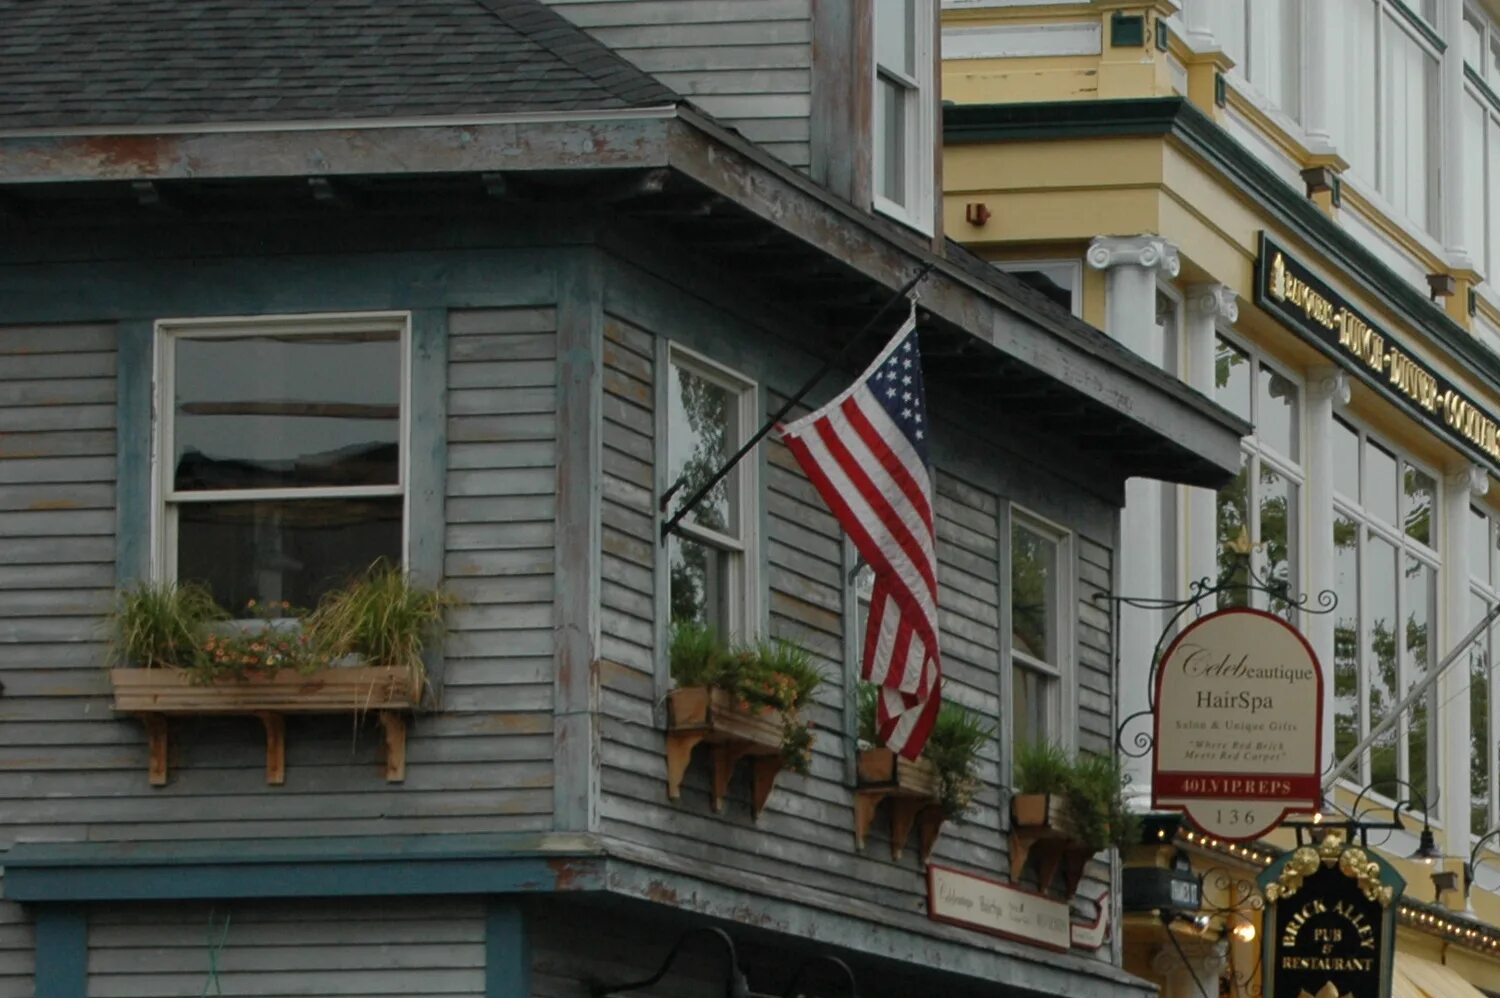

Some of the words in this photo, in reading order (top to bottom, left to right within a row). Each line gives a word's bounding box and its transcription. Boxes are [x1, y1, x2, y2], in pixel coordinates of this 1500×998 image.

[1338, 306, 1384, 374] LUNCH
[1389, 346, 1438, 415] DINNER
[1196, 690, 1273, 713] HairSpa
[1175, 719, 1207, 731] Salon
[1210, 719, 1220, 730] &
[1225, 719, 1264, 733] Unique
[1268, 721, 1297, 732] Gifts
[1232, 740, 1252, 750] Red
[1256, 741, 1284, 751] Brick
[1184, 750, 1216, 761] Meets
[1219, 751, 1240, 761] Red
[1282, 900, 1327, 948] BRICK
[1332, 899, 1376, 950] ALLEY
[1313, 928, 1343, 942] PUB
[1282, 957, 1374, 972] RESTAURANT
